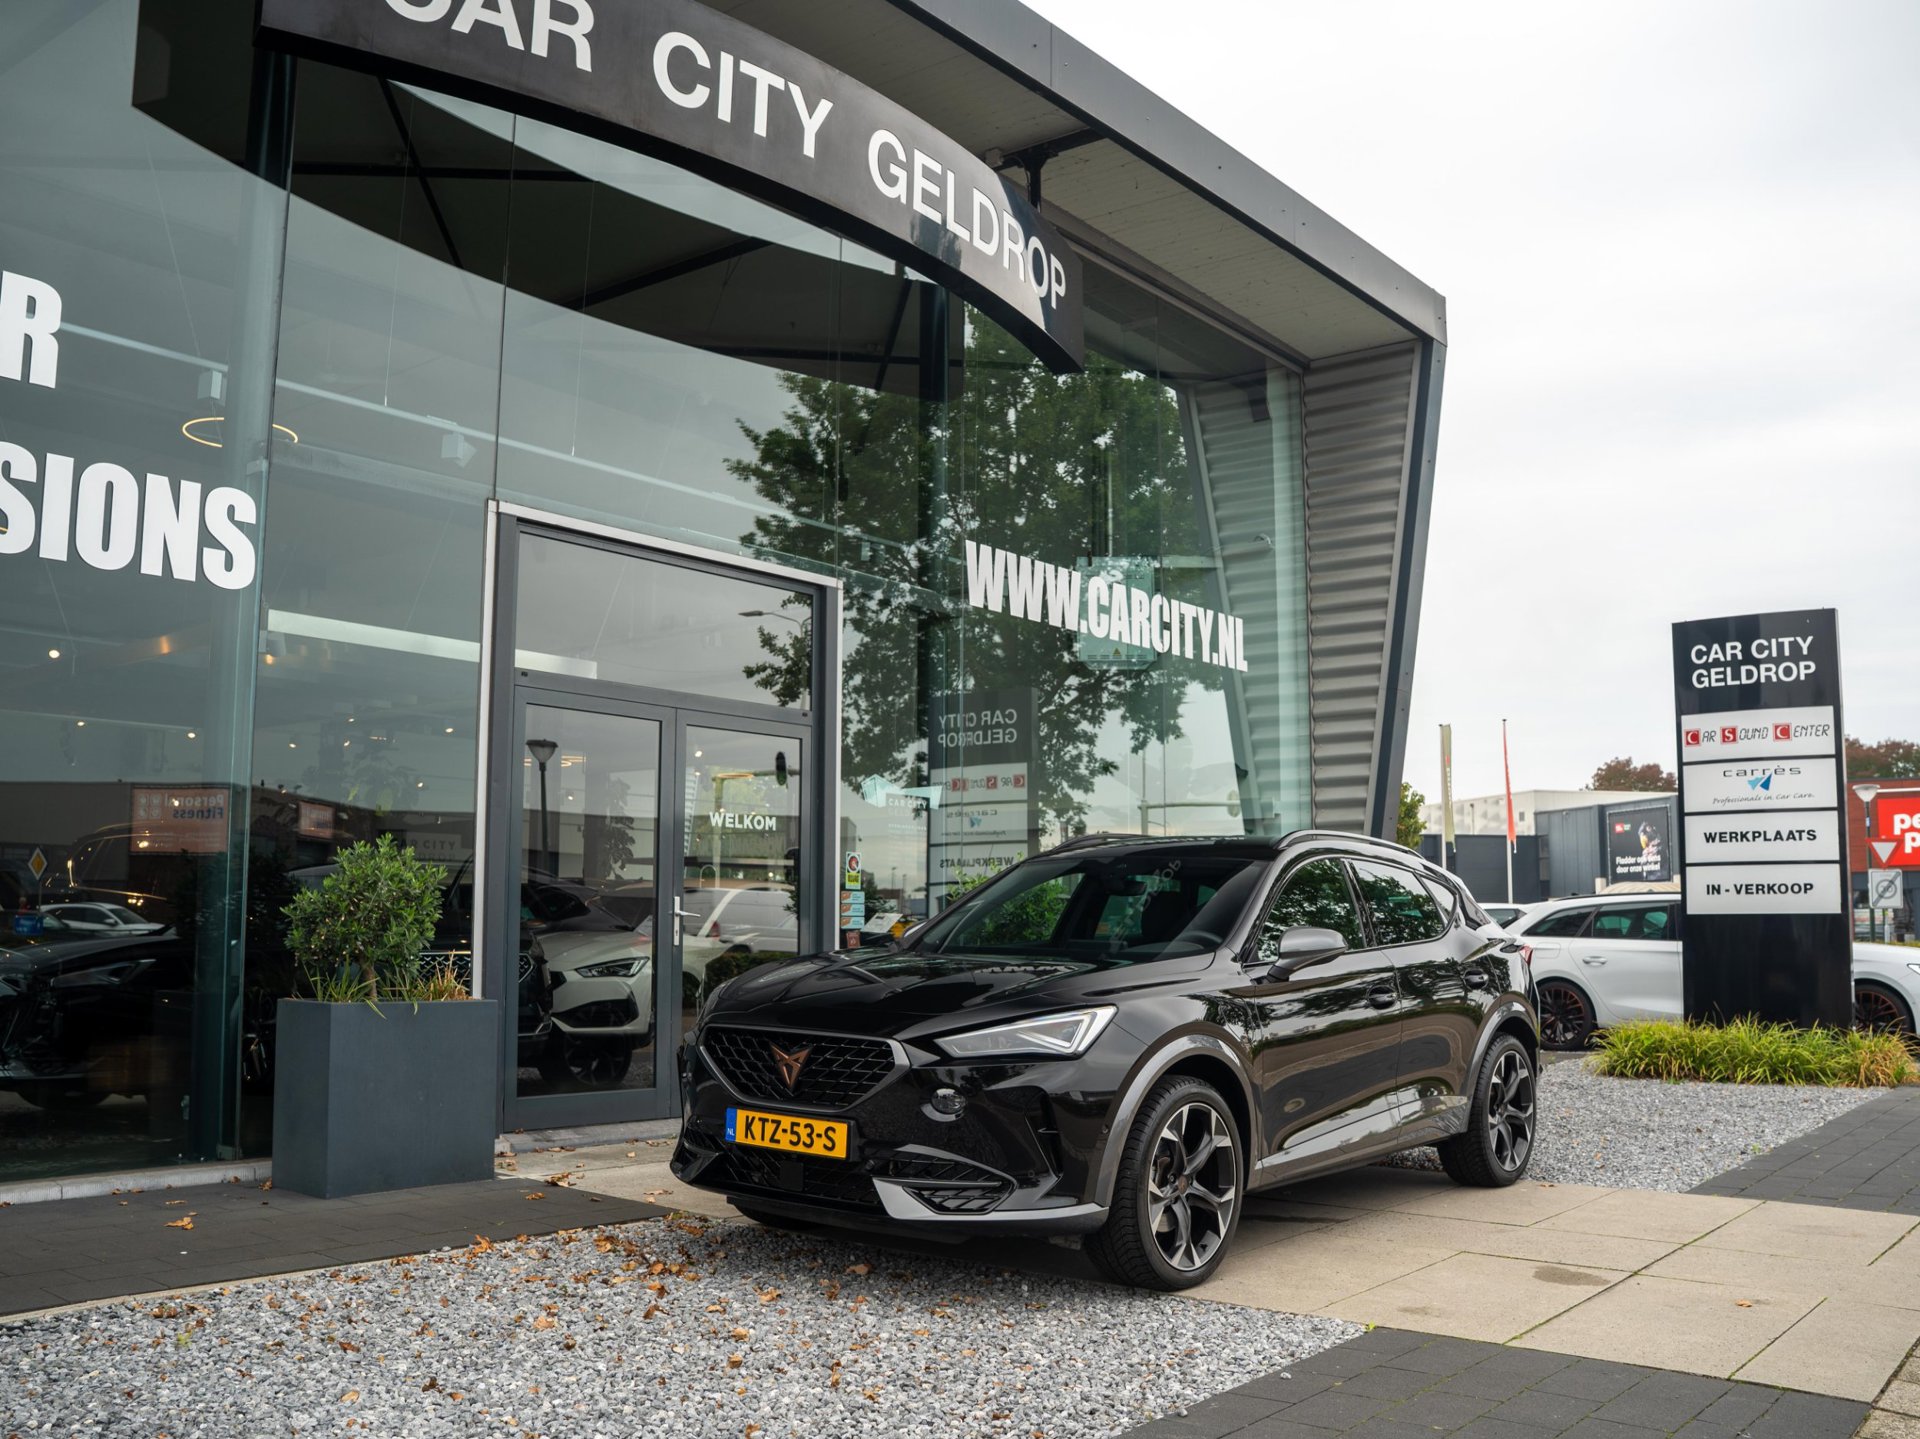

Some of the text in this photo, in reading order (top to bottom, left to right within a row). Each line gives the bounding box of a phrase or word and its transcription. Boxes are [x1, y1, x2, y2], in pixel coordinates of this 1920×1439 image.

[384, 0, 1066, 310] AR CITY GELDROP
[0, 441, 256, 590] SIONS
[965, 539, 1248, 672] WWW.CARCITY.NL
[1690, 636, 1813, 664] CAR CITY
[1692, 661, 1816, 688] GELDROP
[1685, 723, 1830, 746] CAR SOUND CENTER
[709, 811, 777, 831] WELKOM
[1704, 829, 1817, 843] WERKPLAATS
[1706, 884, 1721, 896] IN
[1734, 883, 1814, 895] VERKOOP
[727, 1127, 735, 1136] NL
[744, 1115, 837, 1152] KTZ-53-S
